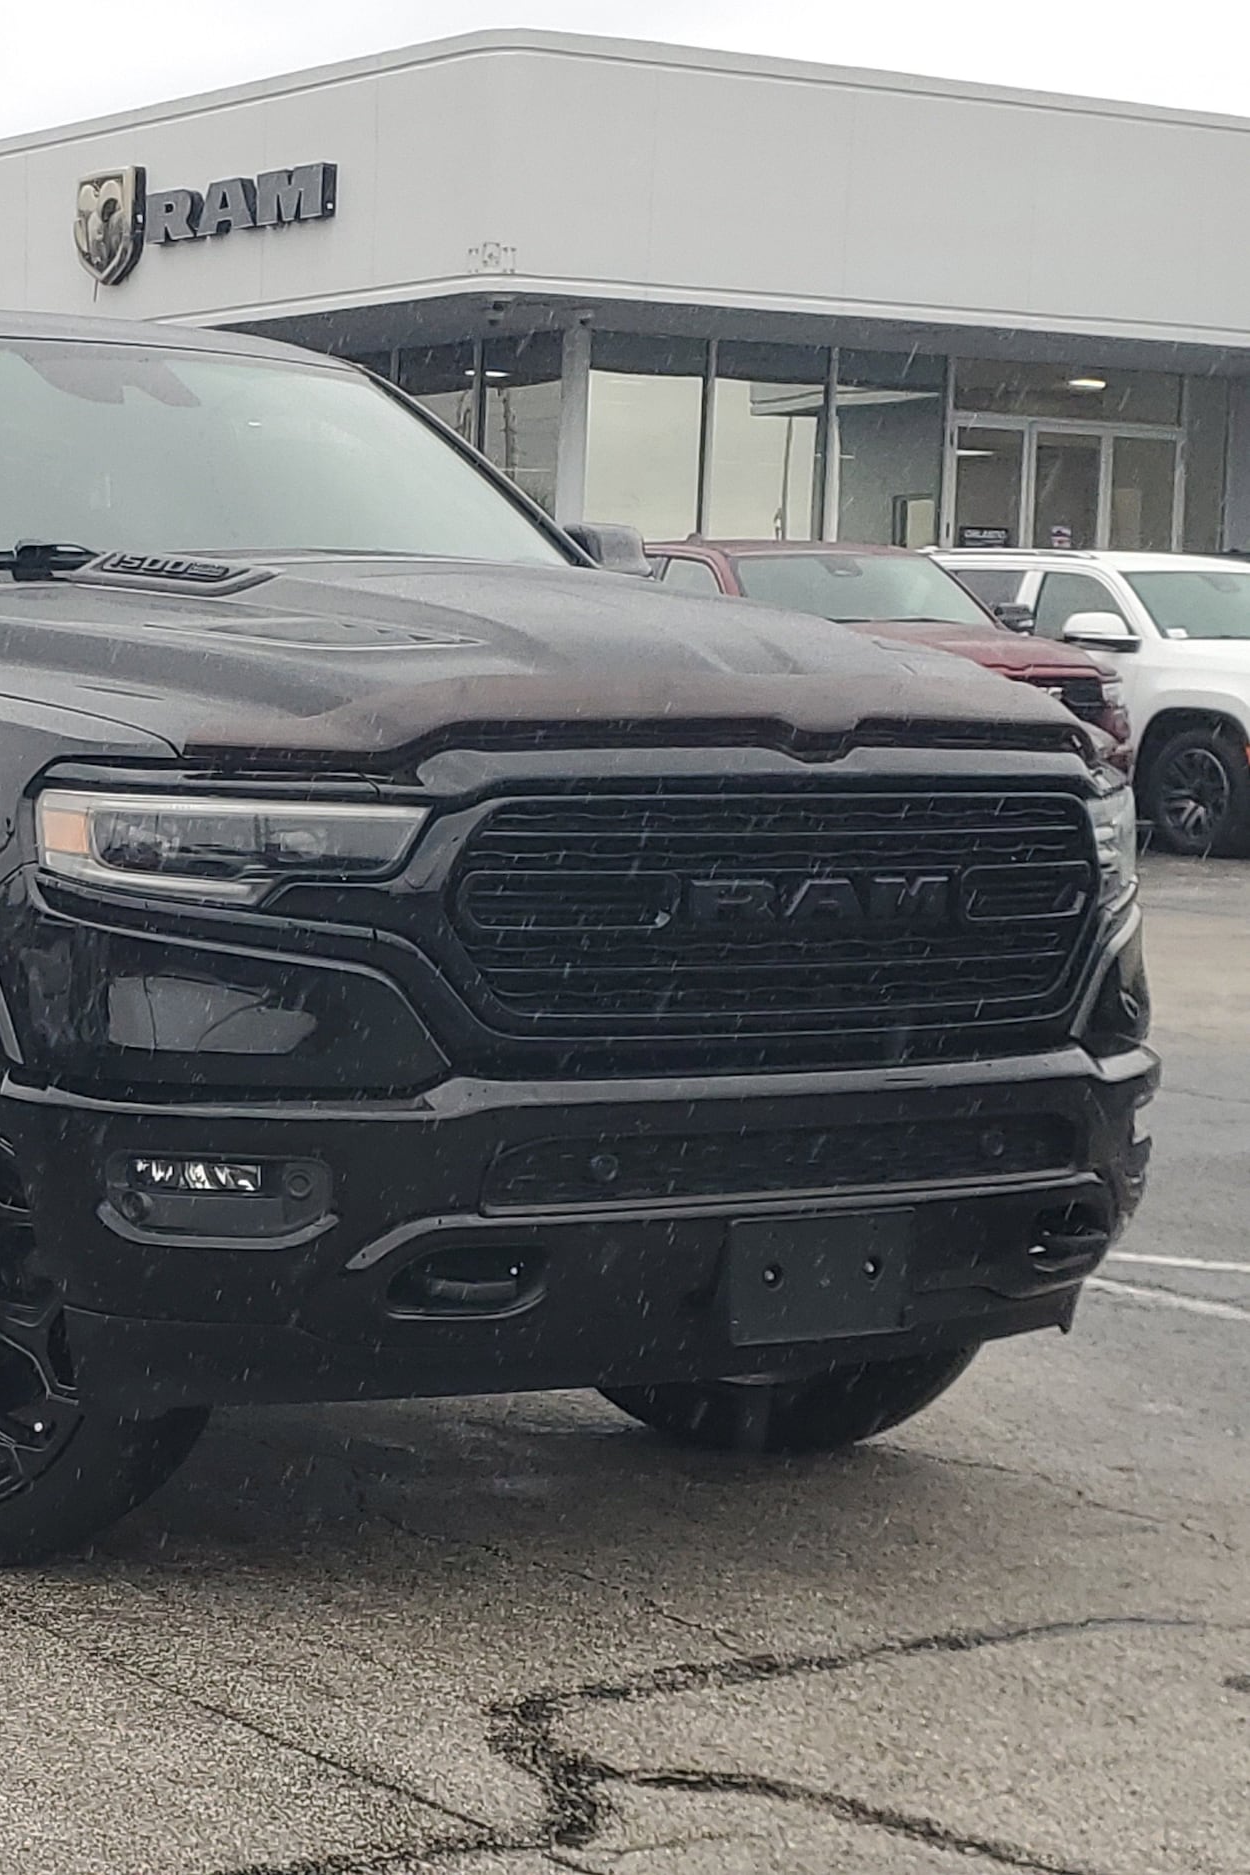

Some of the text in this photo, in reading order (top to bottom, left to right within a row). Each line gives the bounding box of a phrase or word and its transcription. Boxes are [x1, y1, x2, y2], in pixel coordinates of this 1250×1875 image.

[146, 162, 337, 244] RAM
[109, 554, 188, 574] 1500
[689, 877, 949, 918] RAM
